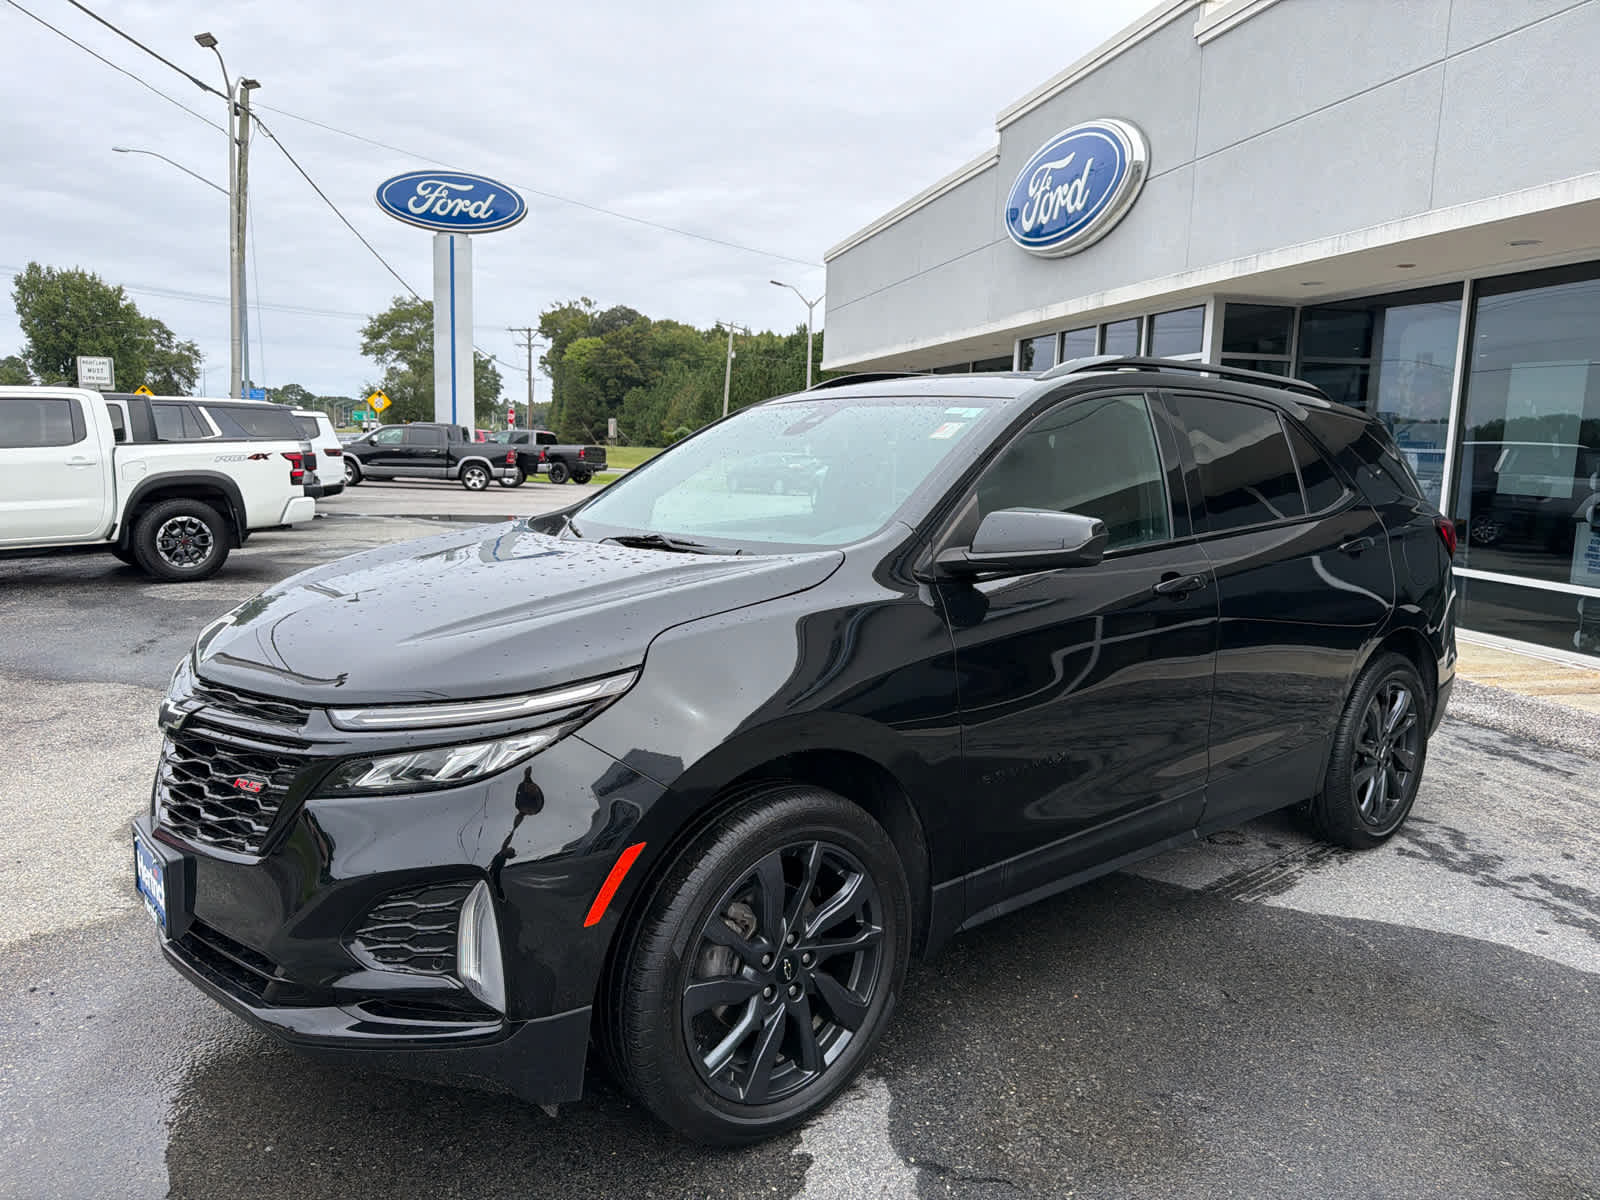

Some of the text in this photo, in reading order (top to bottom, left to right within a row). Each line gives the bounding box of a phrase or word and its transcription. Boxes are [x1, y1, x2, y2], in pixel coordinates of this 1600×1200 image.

[407, 179, 497, 219] Ford
[1021, 151, 1094, 232] Ford
[232, 777, 264, 793] RS
